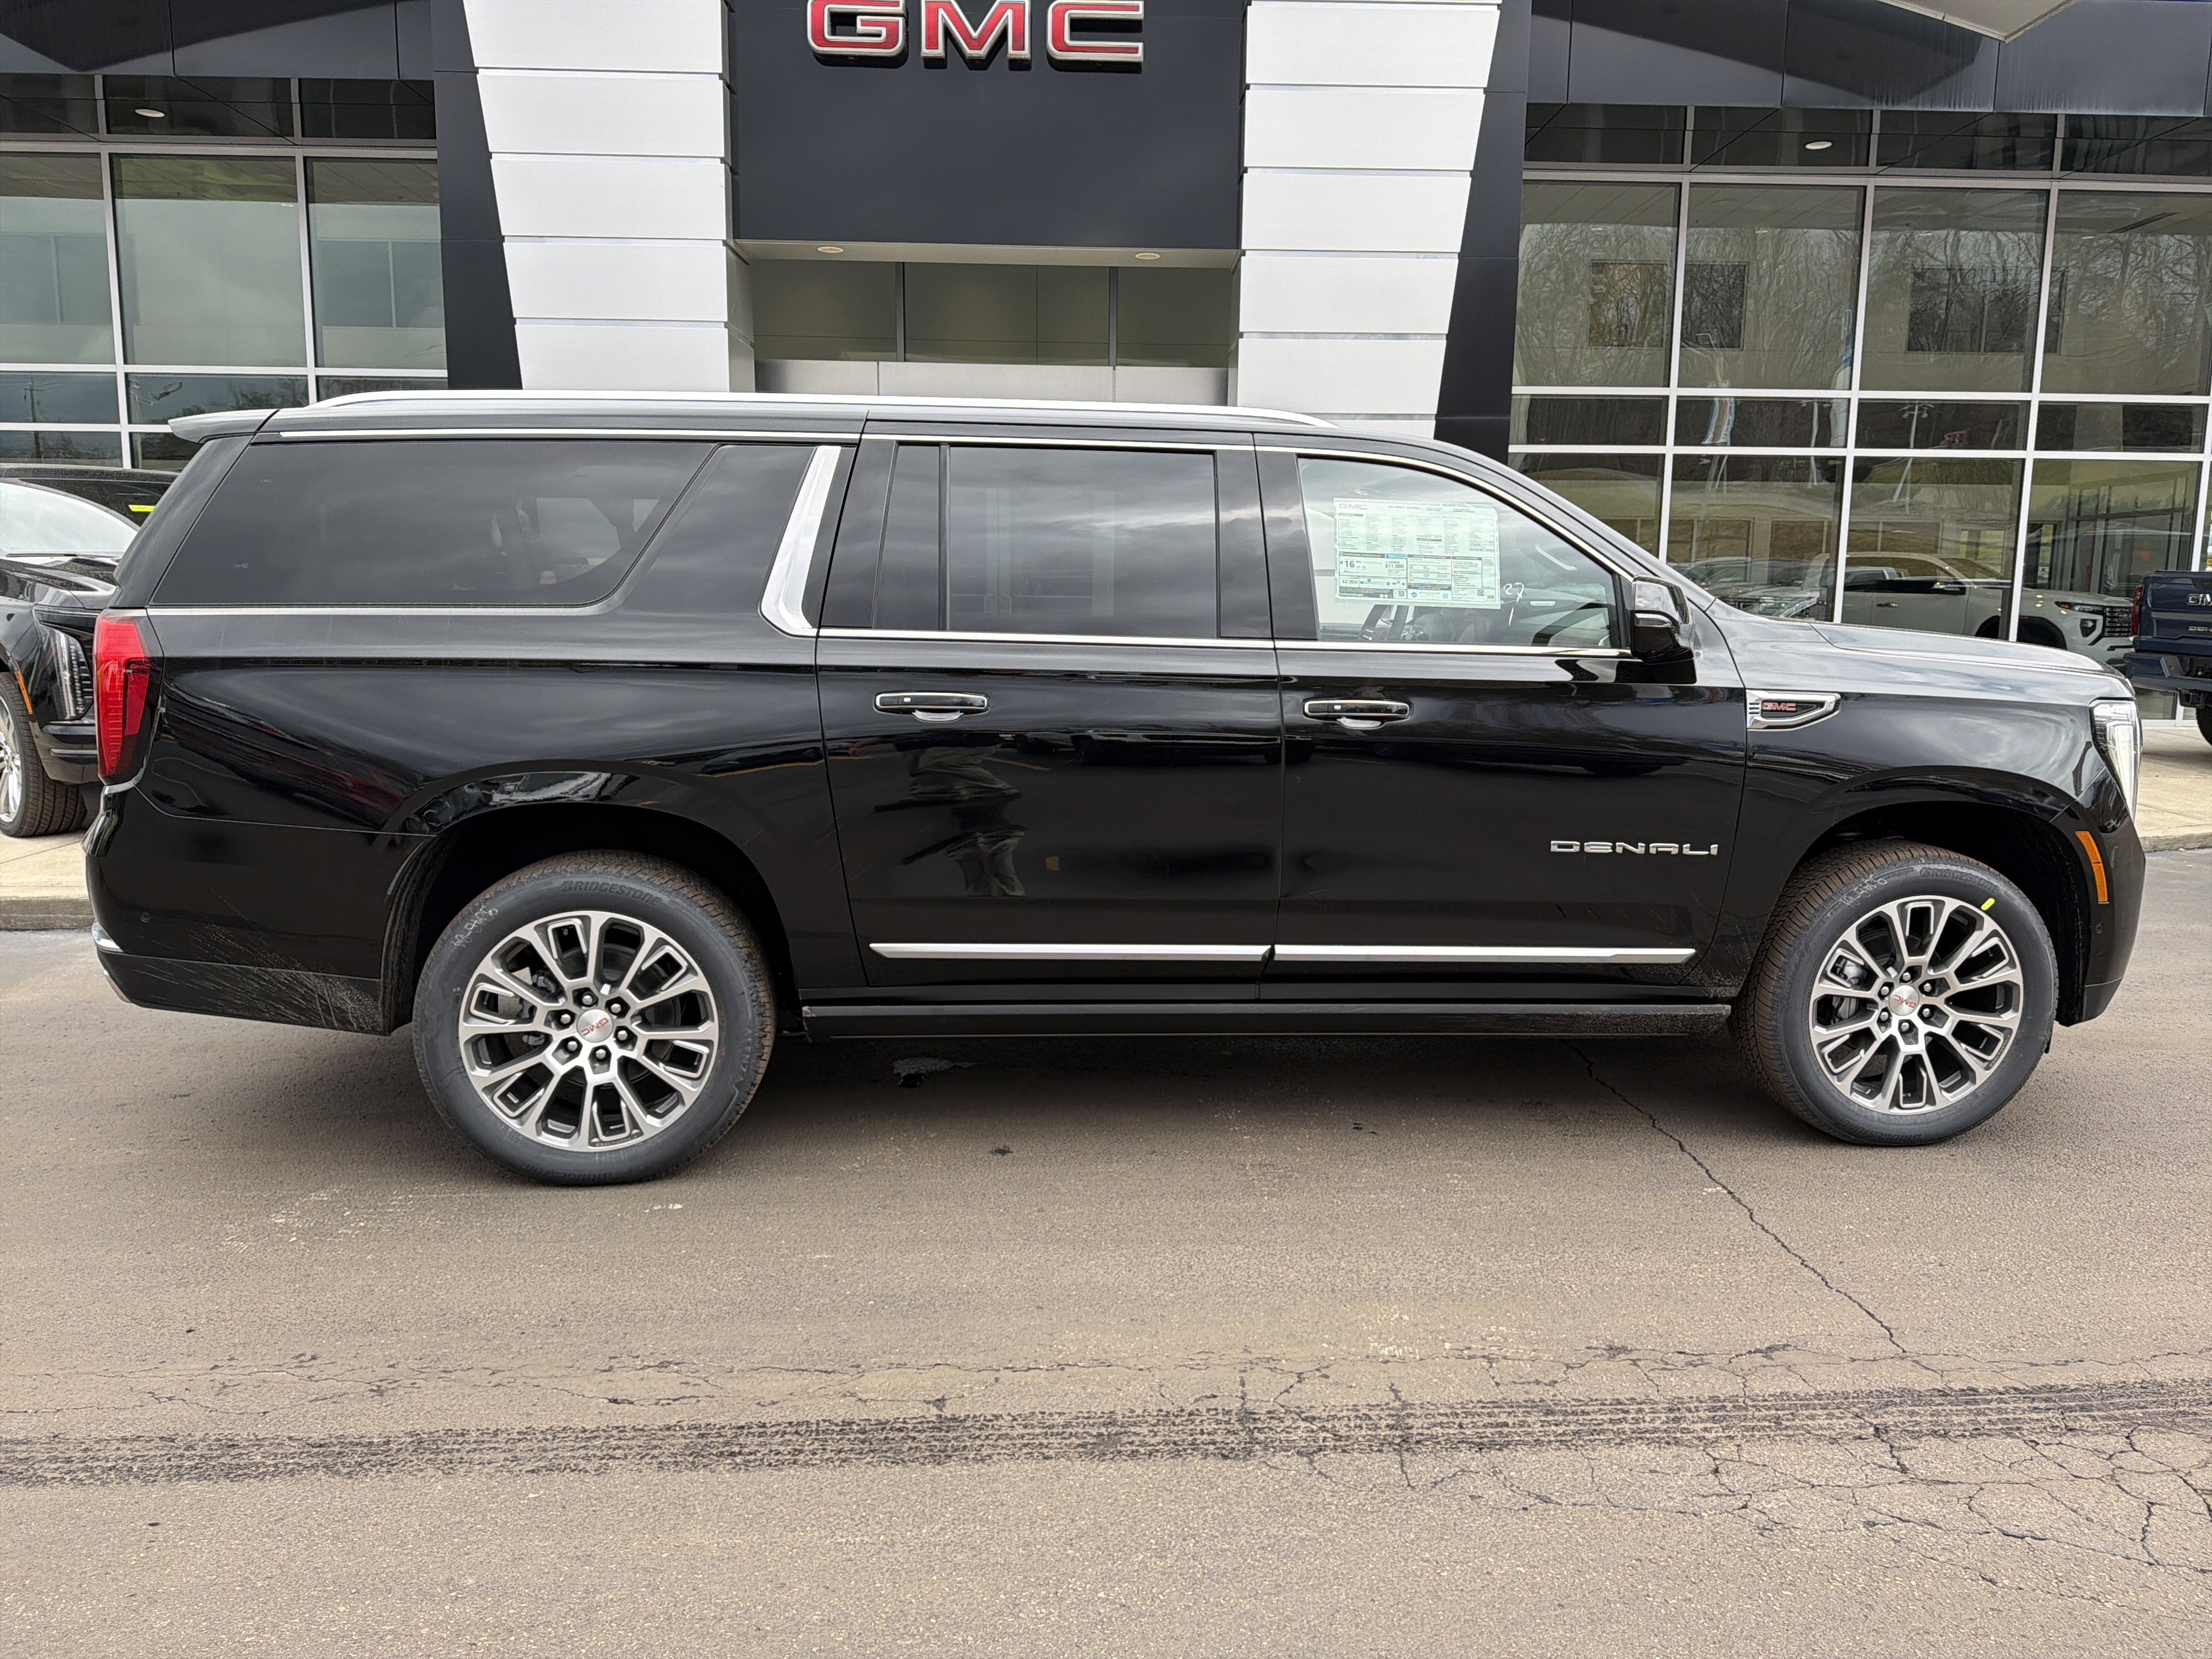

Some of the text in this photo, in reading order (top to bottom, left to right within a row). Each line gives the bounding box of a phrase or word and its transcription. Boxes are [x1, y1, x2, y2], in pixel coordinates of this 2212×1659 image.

[806, 0, 1144, 64] GMC
[1344, 560, 1355, 568] 16
[1762, 702, 1797, 712] GMC
[1550, 840, 1718, 856] DENALI
[560, 879, 663, 907] BRIDGESTONE
[1893, 994, 1916, 1008] GMC
[580, 1017, 608, 1036] GMC
